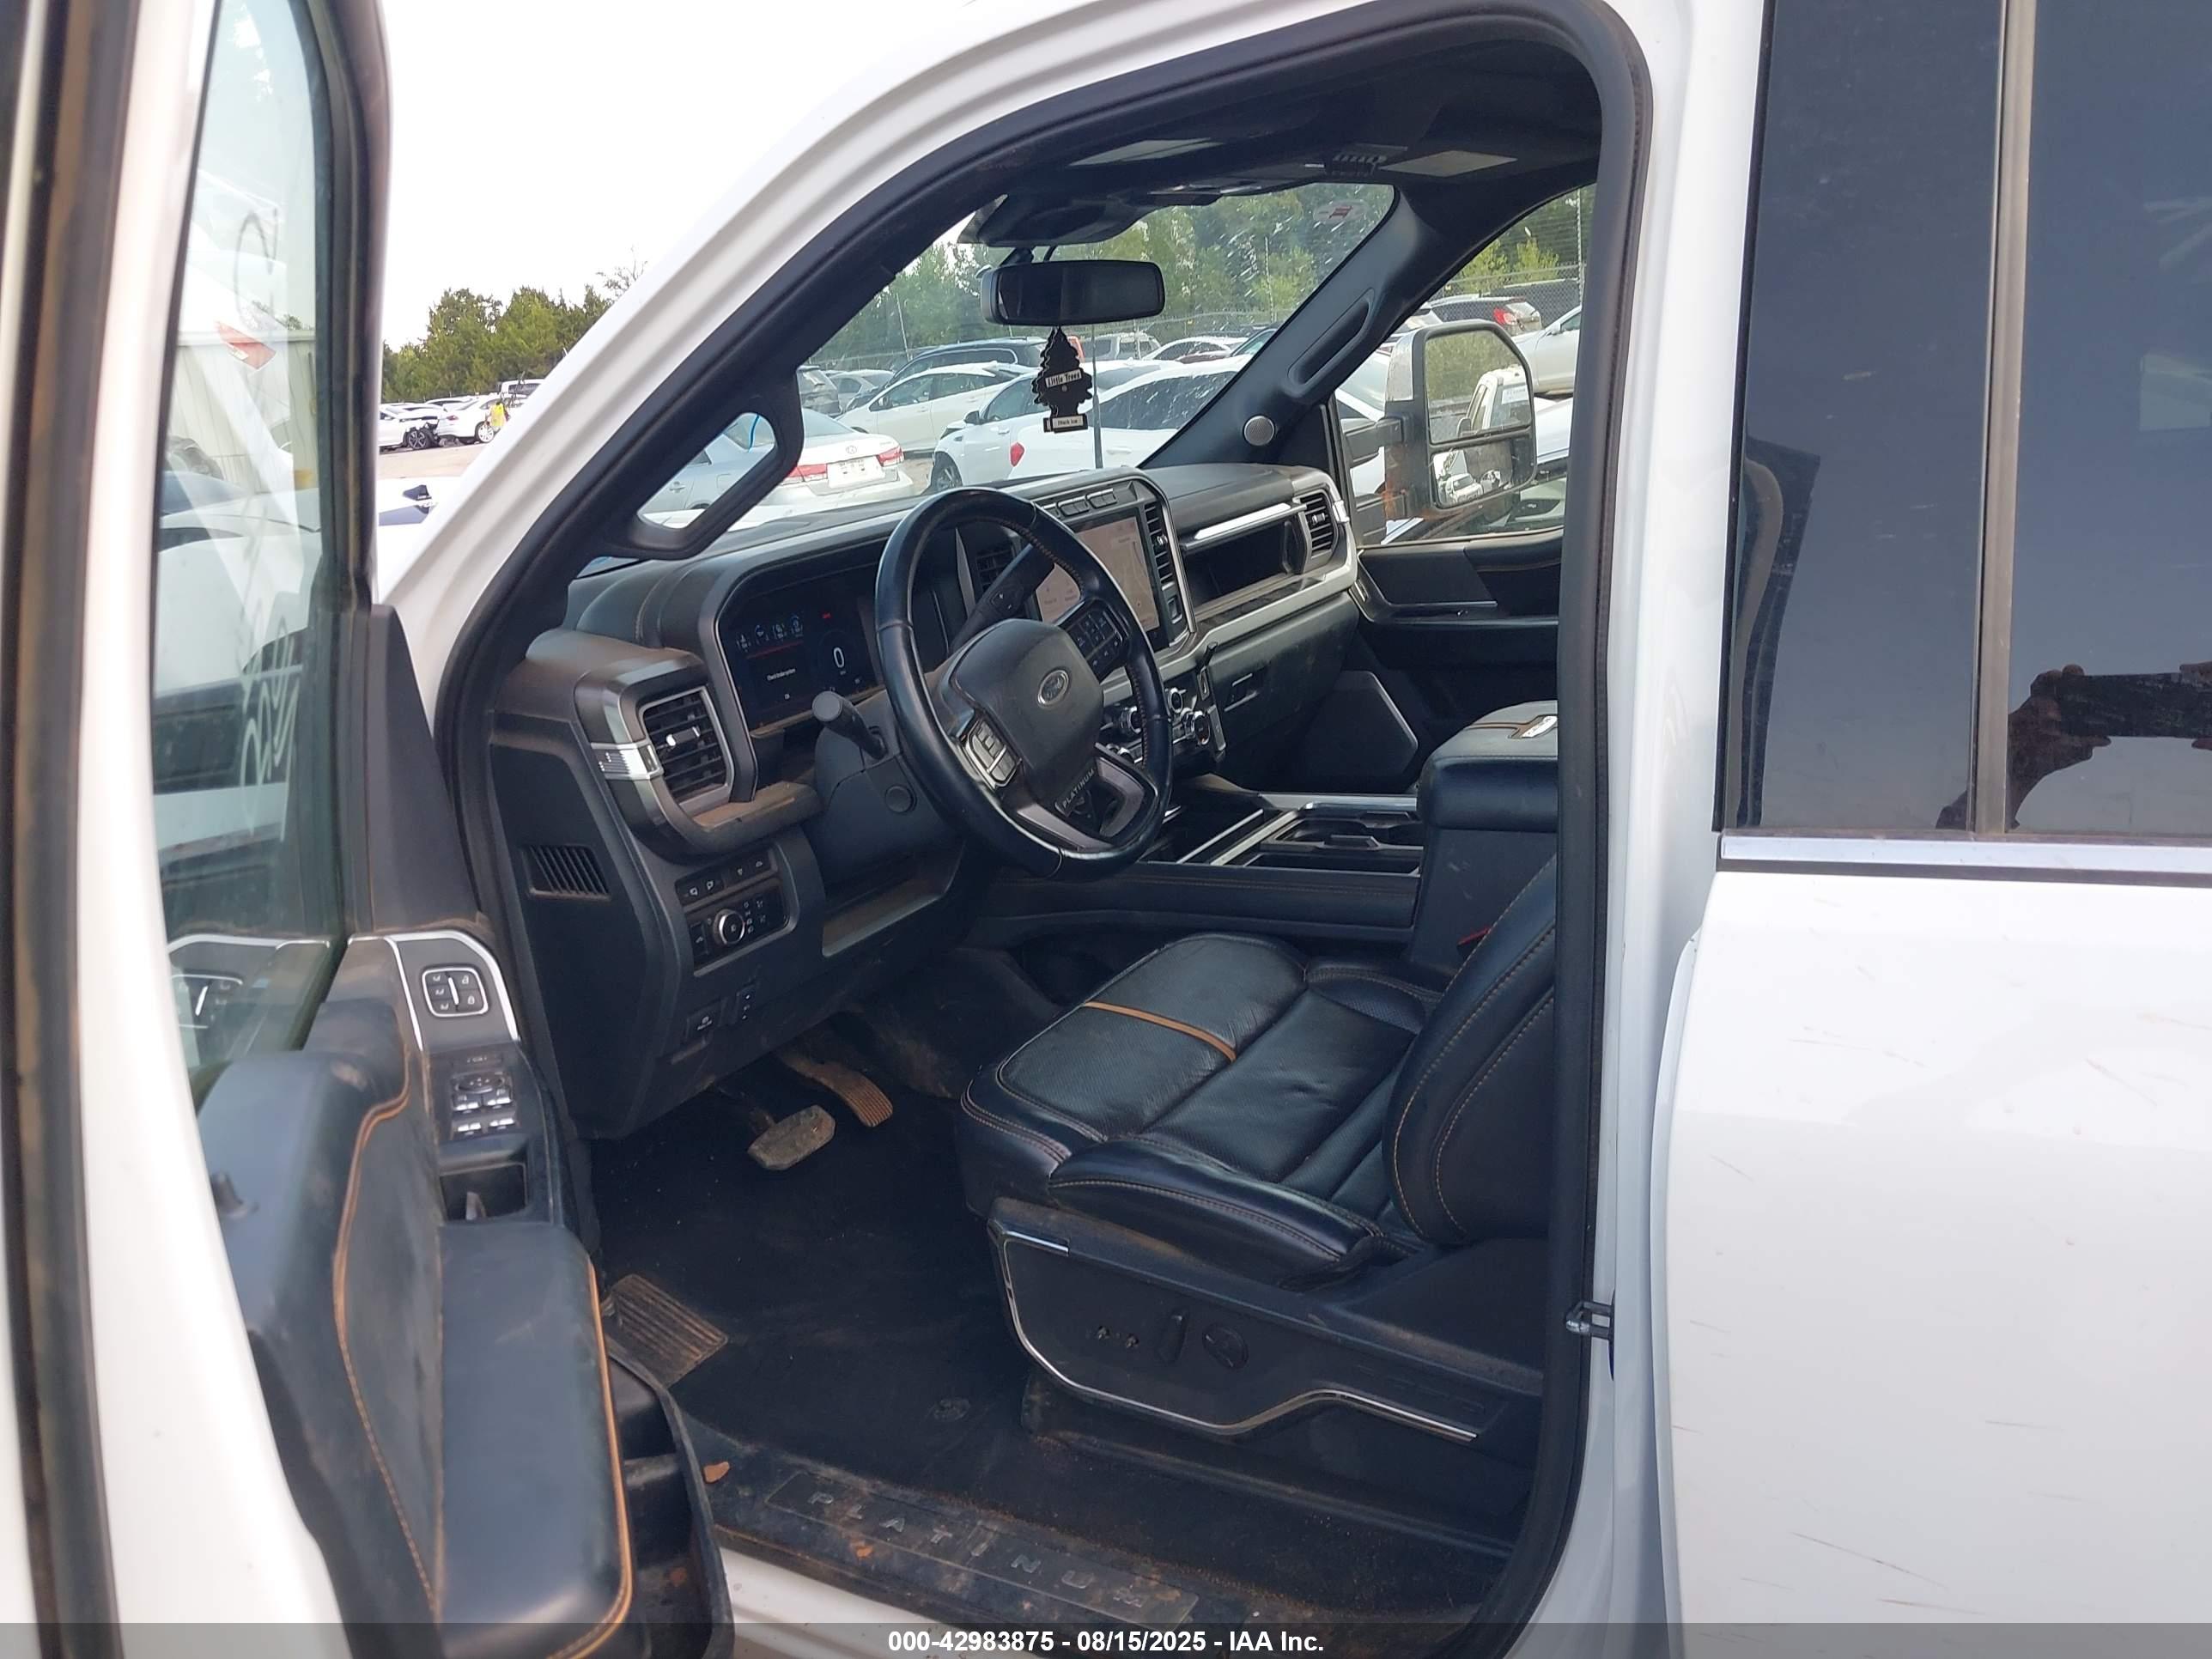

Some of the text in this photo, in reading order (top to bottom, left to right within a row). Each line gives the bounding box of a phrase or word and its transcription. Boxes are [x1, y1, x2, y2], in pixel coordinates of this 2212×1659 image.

[833, 647, 845, 668] 0
[1062, 769, 1095, 809] PLATINUM
[807, 1492, 1146, 1608] PLATINUM
